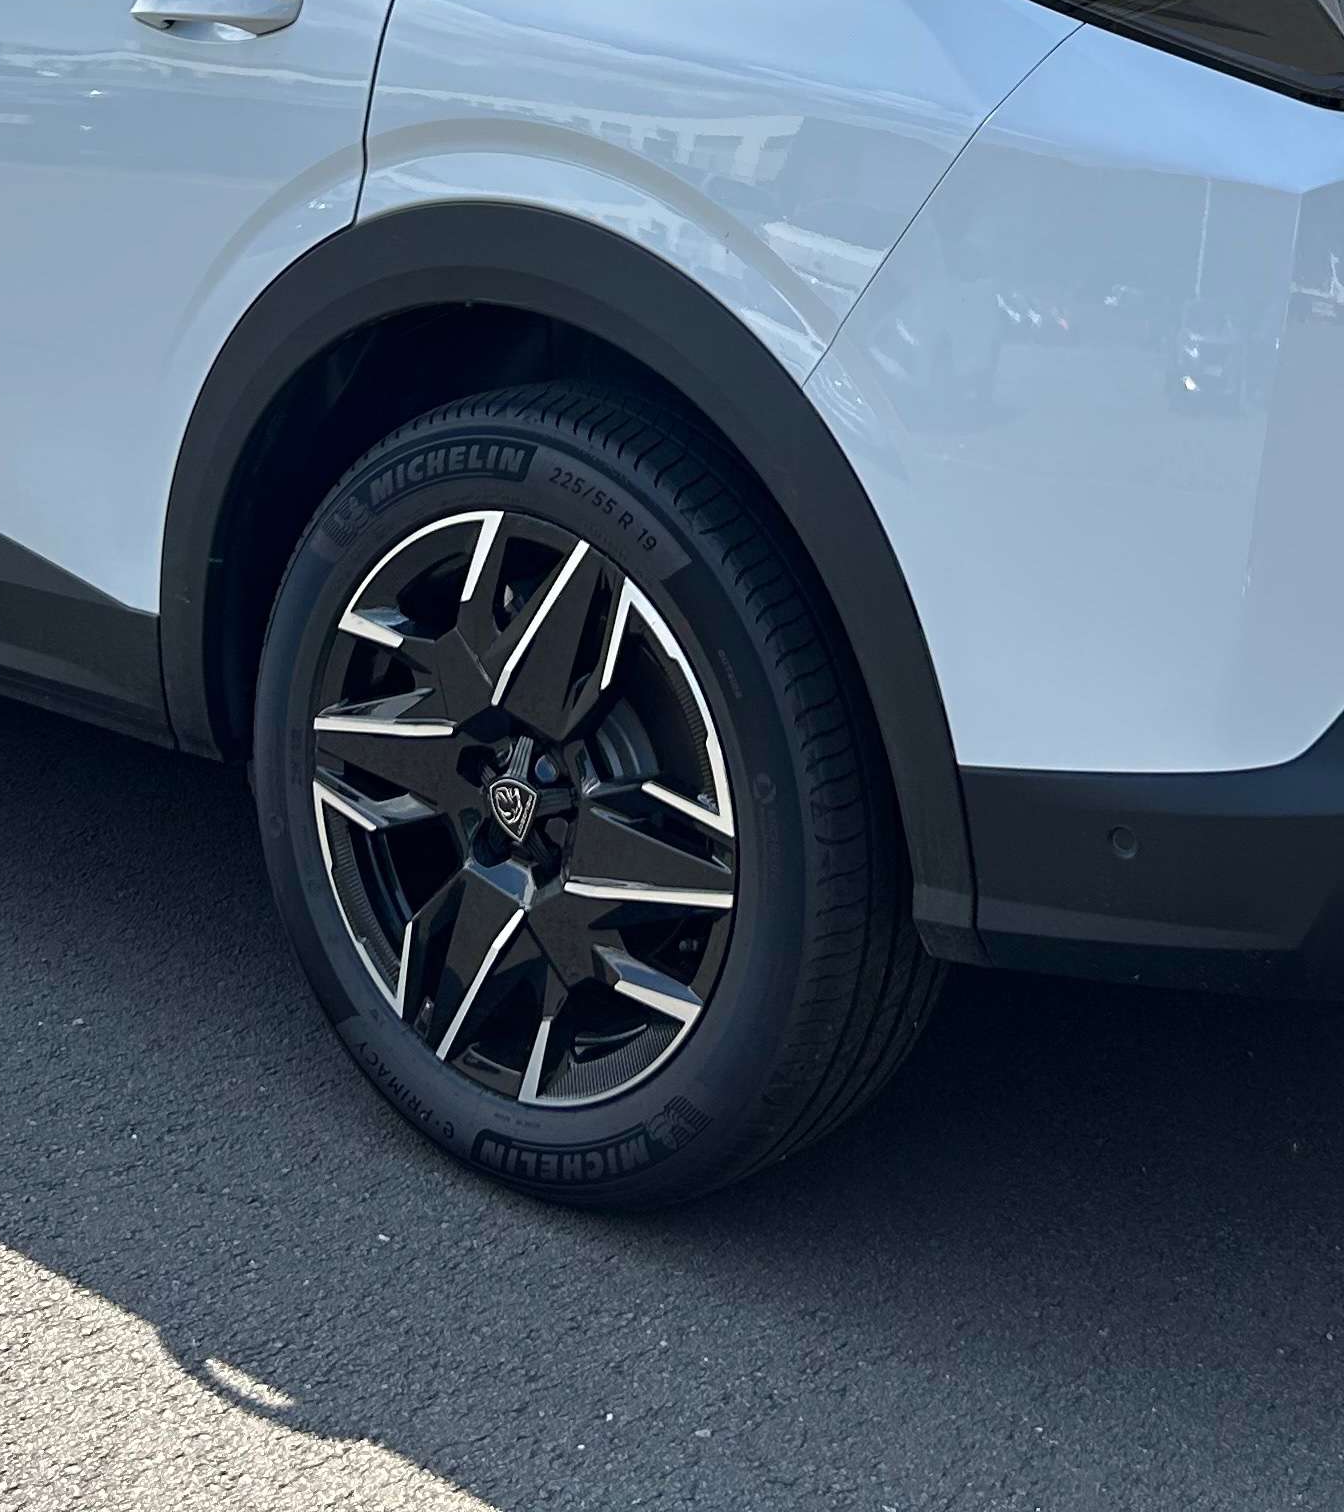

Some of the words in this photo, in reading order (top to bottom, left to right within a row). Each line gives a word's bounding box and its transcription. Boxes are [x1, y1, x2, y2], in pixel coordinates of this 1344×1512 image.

[368, 444, 526, 506] MICHELIN
[549, 467, 618, 515] 225/55
[617, 510, 634, 530] R
[636, 528, 657, 551] 19
[480, 1130, 651, 1180] MICHELIN
